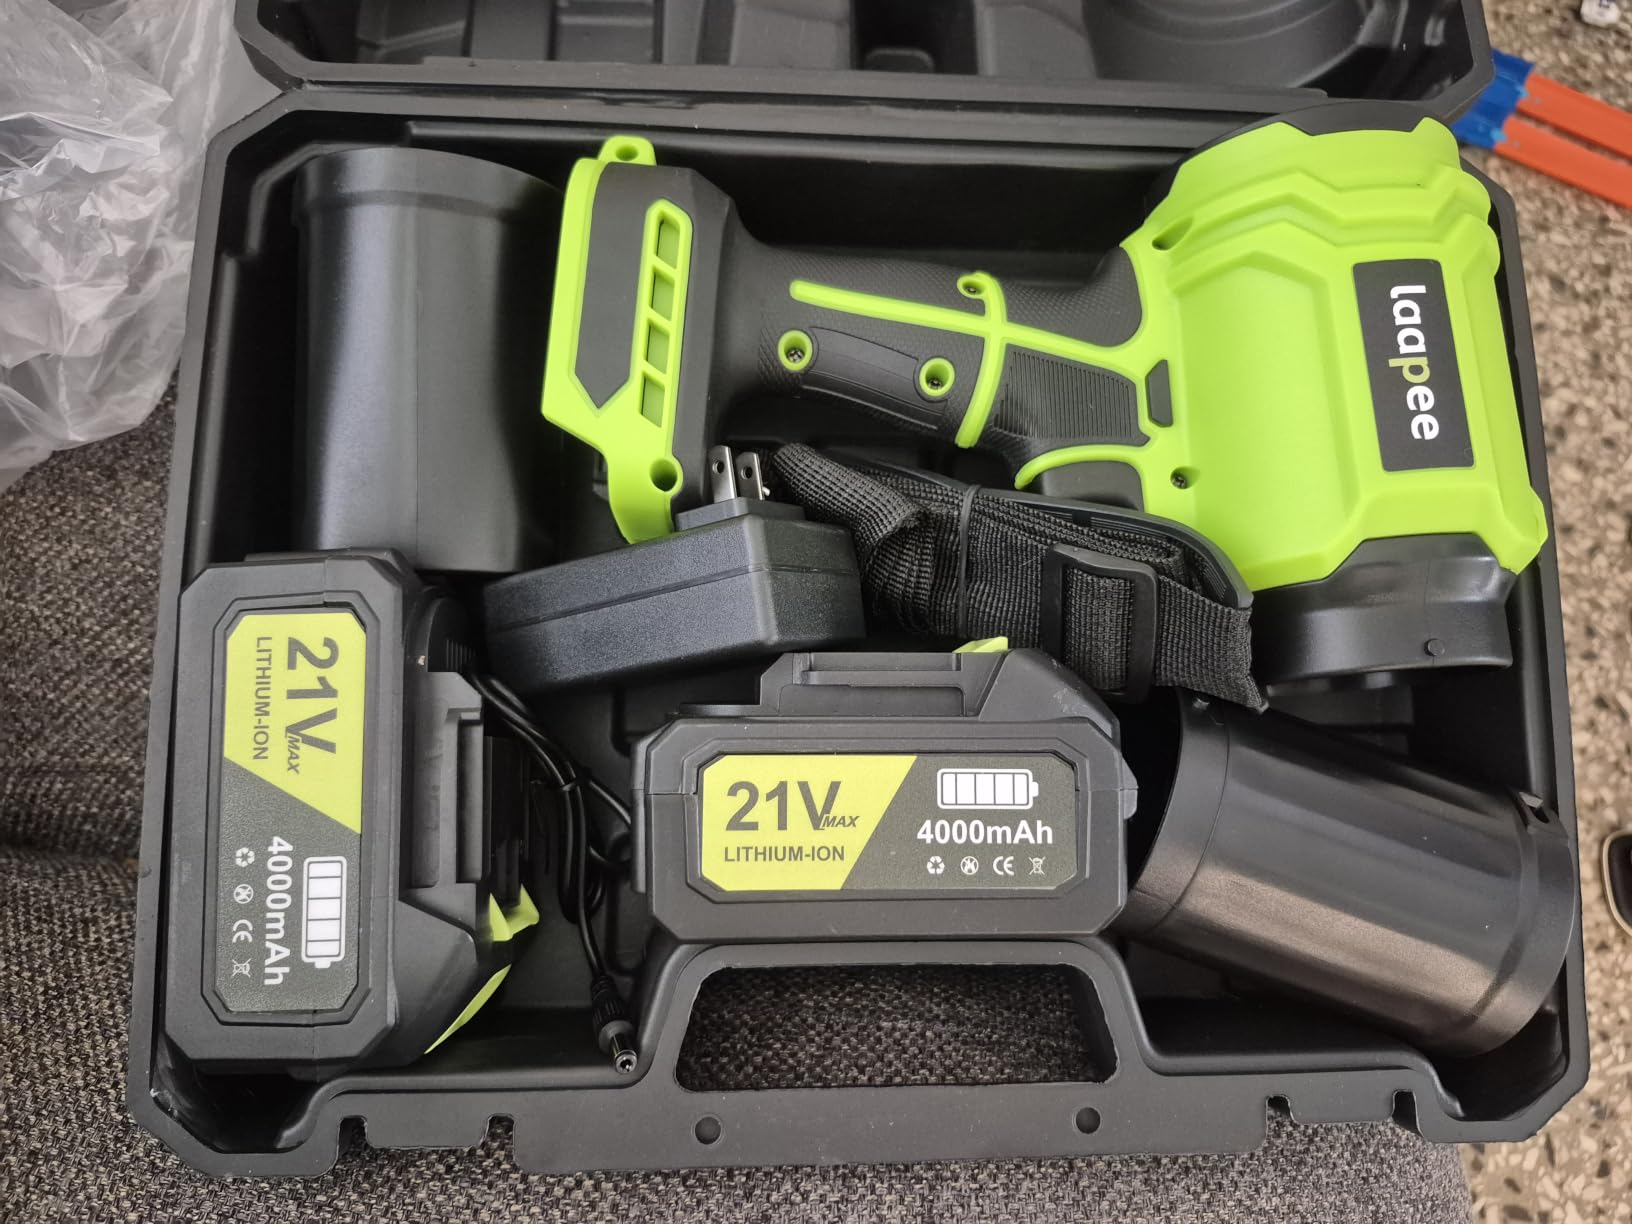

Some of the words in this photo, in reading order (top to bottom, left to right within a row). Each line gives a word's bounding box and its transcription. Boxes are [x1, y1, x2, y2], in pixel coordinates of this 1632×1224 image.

[1388, 284, 1440, 441] laapee
[252, 636, 273, 761] LITHIUM-ION
[286, 636, 340, 754] 21V
[285, 733, 301, 775] MAX
[725, 780, 842, 832] 21V
[821, 814, 860, 828] MAX
[916, 818, 1054, 845] 4000mAh
[724, 845, 845, 862] LITHIUM-ION
[263, 835, 294, 986] 4000mAh
